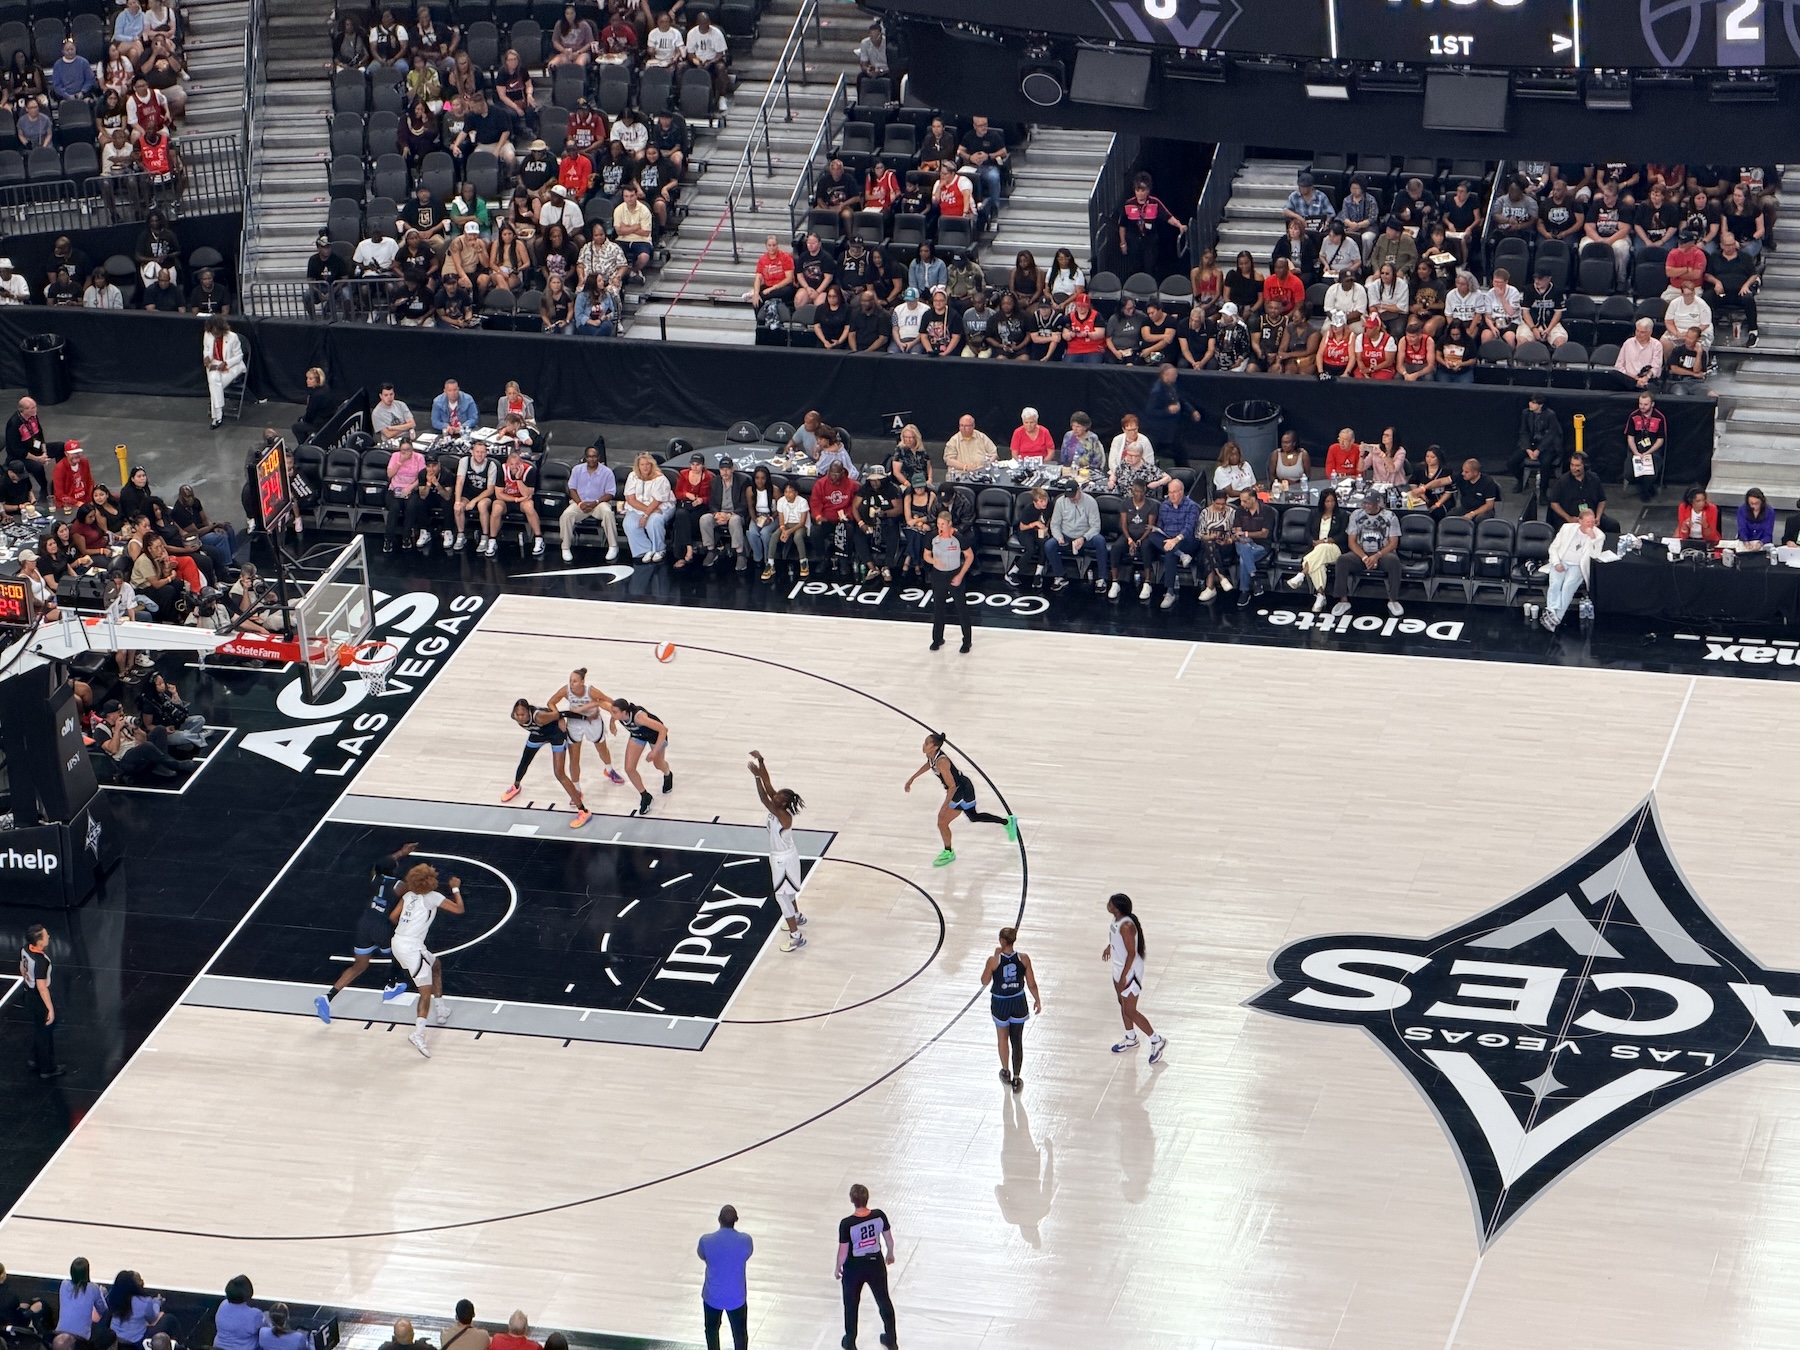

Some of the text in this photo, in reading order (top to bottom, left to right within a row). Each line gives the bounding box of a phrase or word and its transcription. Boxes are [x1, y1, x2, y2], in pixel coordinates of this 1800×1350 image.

[1726, 0, 1760, 40] 2
[1430, 35, 1474, 56] 1ST
[844, 262, 857, 271] 22
[1262, 328, 1271, 340] 15
[1364, 350, 1384, 358] USA
[892, 415, 905, 429] A
[261, 471, 284, 517] 24
[787, 580, 1051, 615] Goole Pixel
[1256, 608, 1465, 642] Deloitte.
[314, 594, 484, 776] LAS VEGAS
[61, 716, 75, 737] ally
[66, 751, 81, 772] IPSY
[654, 883, 768, 985] IPSY
[1002, 962, 1017, 978] 12
[1288, 948, 1800, 1048] ACES
[1403, 1026, 1716, 1067] LAS VEGAS
[860, 1223, 876, 1241] 22
[322, 1325, 330, 1347] F
